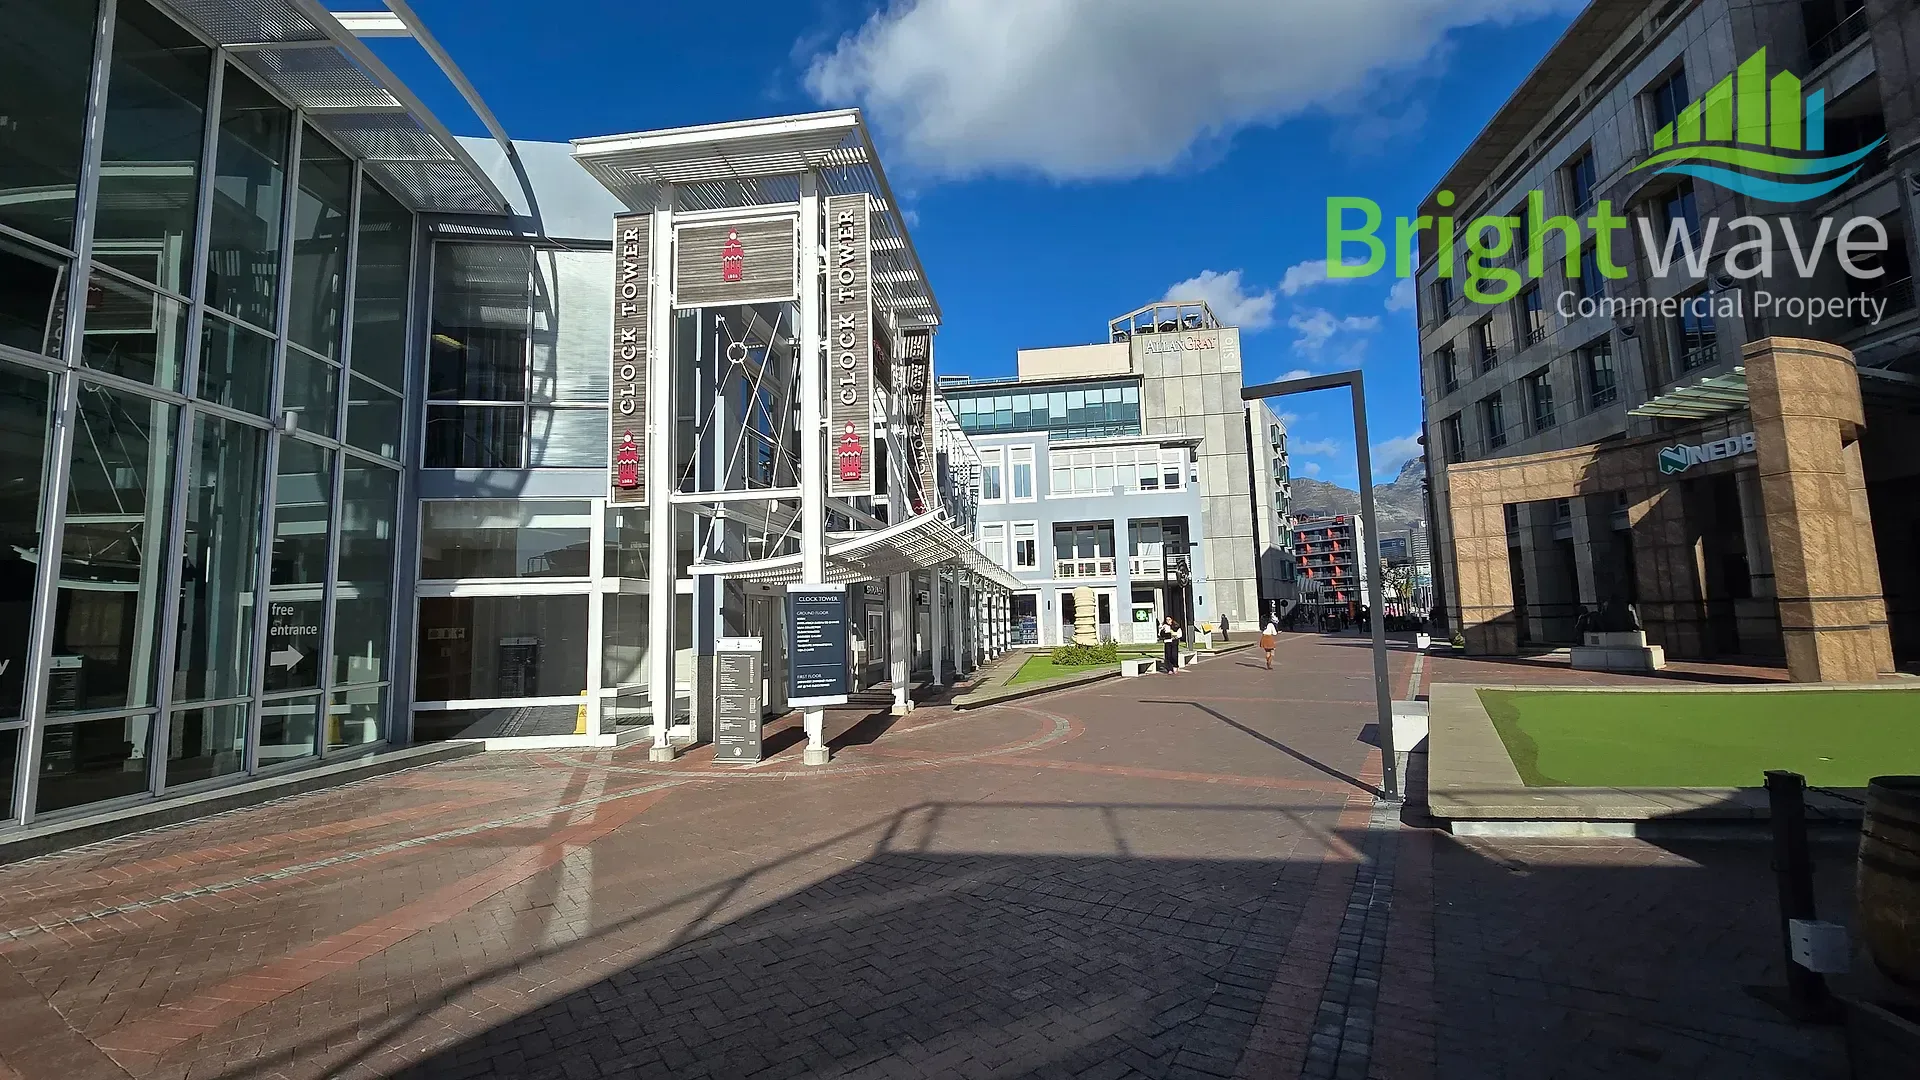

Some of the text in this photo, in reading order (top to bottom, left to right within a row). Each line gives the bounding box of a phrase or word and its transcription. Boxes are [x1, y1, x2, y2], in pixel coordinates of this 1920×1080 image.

[837, 209, 857, 405] CLOCK TOWER
[619, 226, 639, 415] CLOCK TOWER
[1222, 337, 1235, 359] Silo
[271, 603, 294, 616] free
[270, 624, 318, 636] entrance
